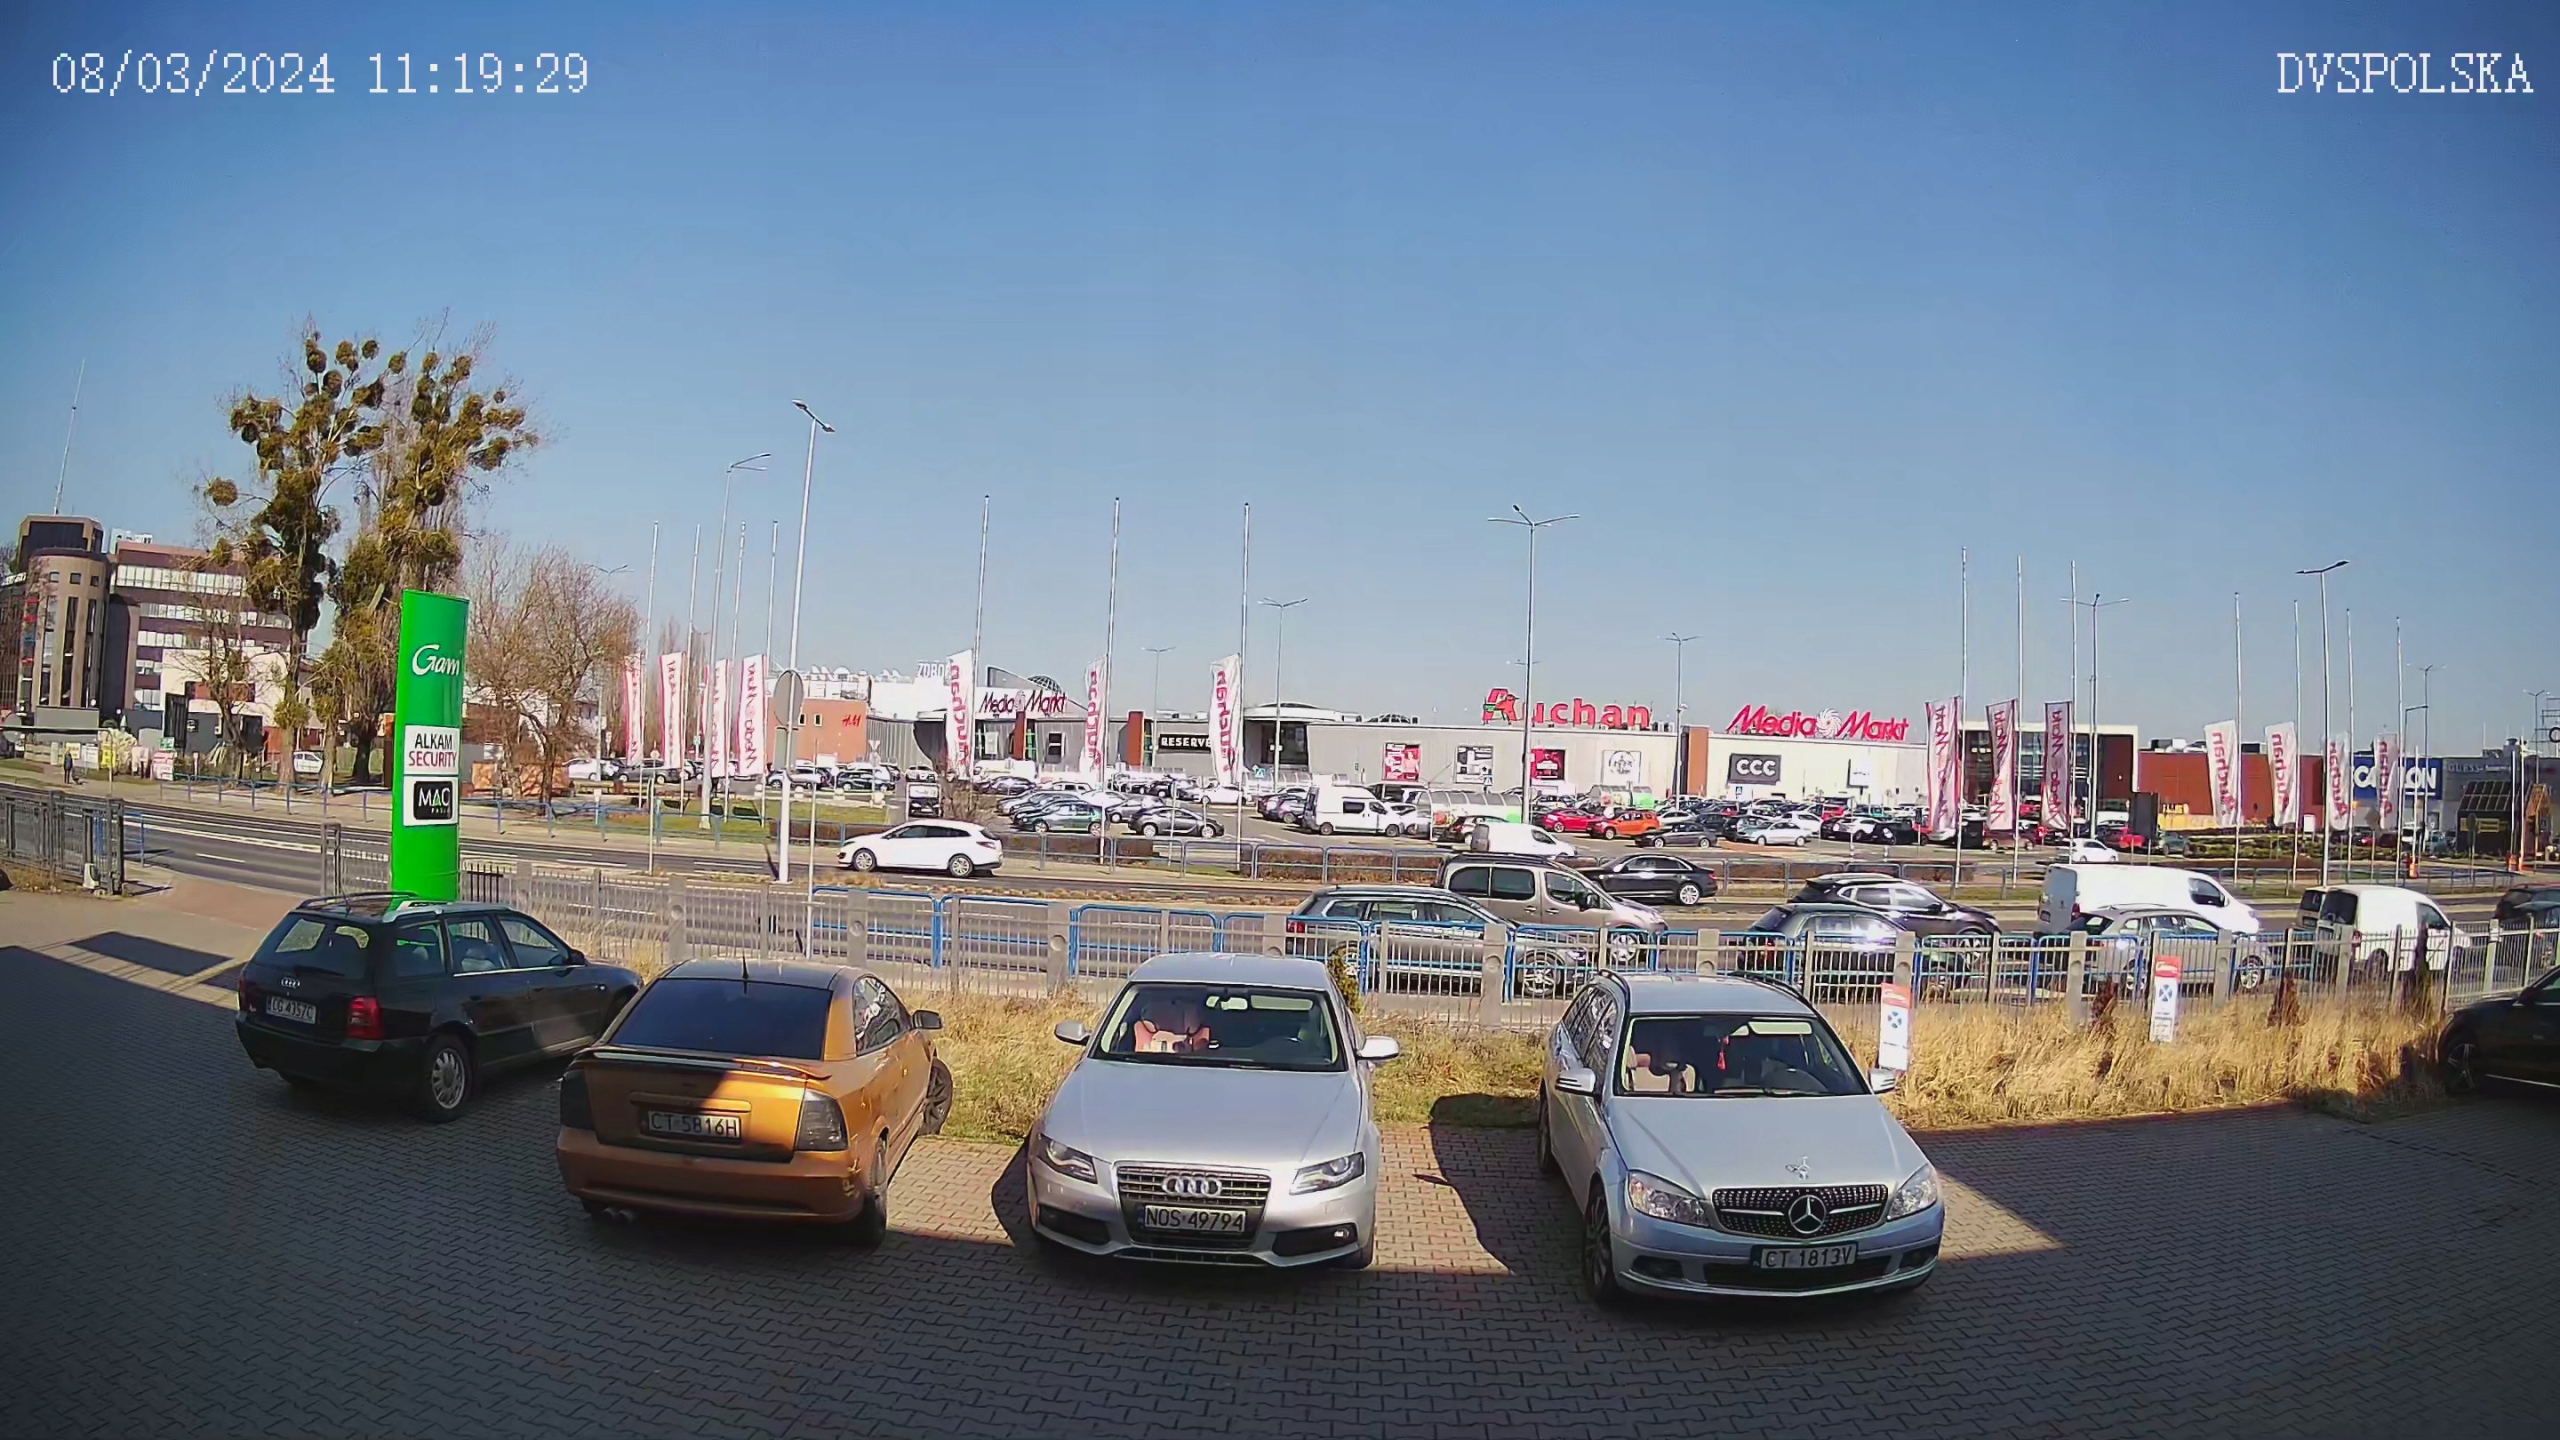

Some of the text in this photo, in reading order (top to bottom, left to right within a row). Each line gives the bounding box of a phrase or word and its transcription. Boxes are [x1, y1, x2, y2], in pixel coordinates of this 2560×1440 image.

[979, 690, 1067, 714] Media Markt
[1482, 688, 1651, 729] Auchan
[1726, 704, 1910, 741] Media Markt
[414, 733, 453, 750] ALKAM
[408, 751, 457, 768] SECURITY
[1736, 758, 1776, 777] CCC
[651, 1113, 737, 1138] CT 5816H
[1146, 1208, 1244, 1232] NOS 49794
[1765, 1246, 1853, 1268] CT 1813V
